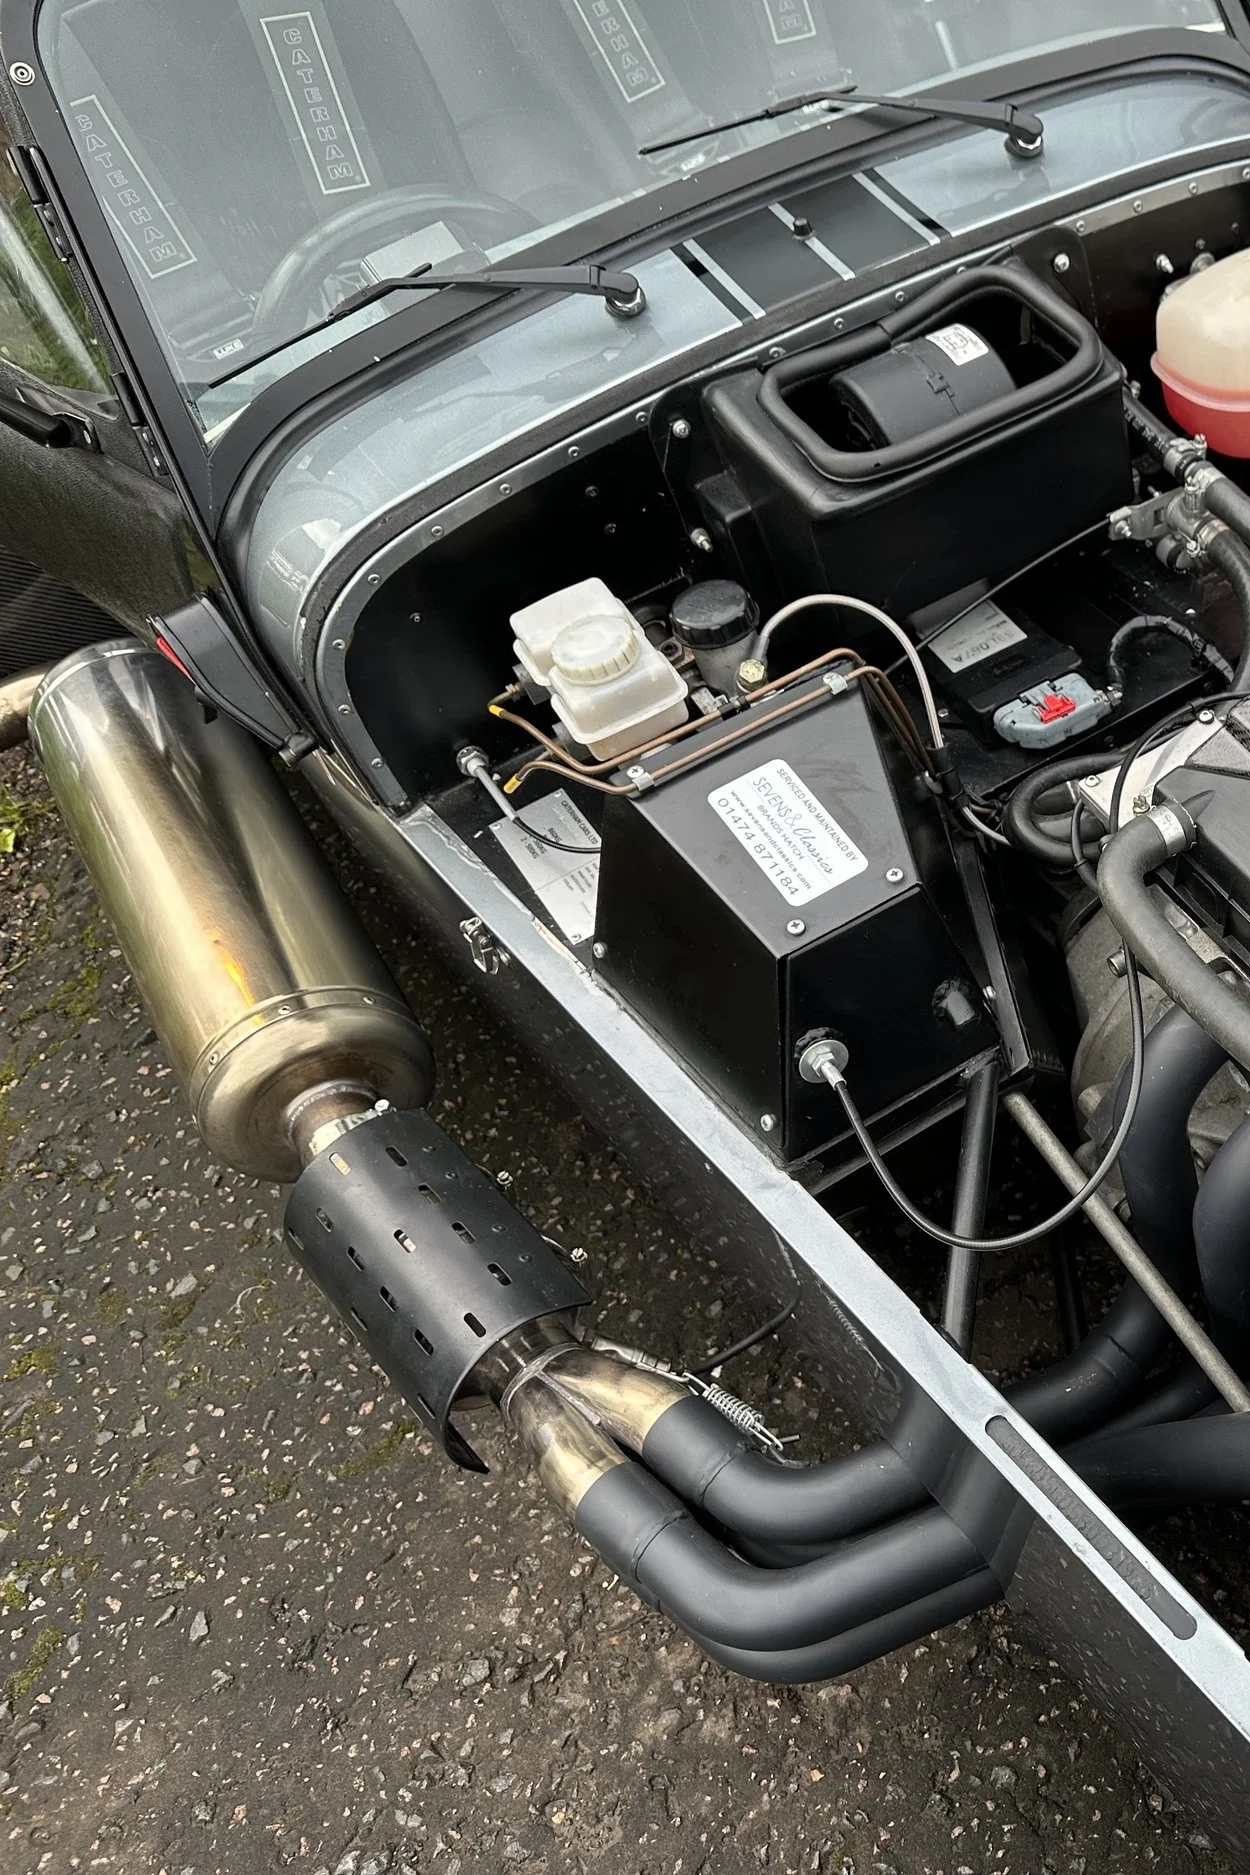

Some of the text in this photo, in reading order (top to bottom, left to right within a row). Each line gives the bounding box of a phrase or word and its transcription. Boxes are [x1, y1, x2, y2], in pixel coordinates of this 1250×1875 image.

[283, 28, 353, 180] CATERHAM
[75, 114, 178, 262] CATERHAM
[561, 800, 582, 826] CATERHAM
[579, 823, 592, 837] CARS
[588, 833, 599, 845] LTD
[730, 790, 812, 890] www.sevensandclassics.com
[753, 777, 792, 818] SEVENS
[757, 805, 805, 860] BRANDS HATCH
[776, 768, 859, 861] SERVICED AND MAINTAINED BY
[717, 798, 799, 896] 01474 871184
